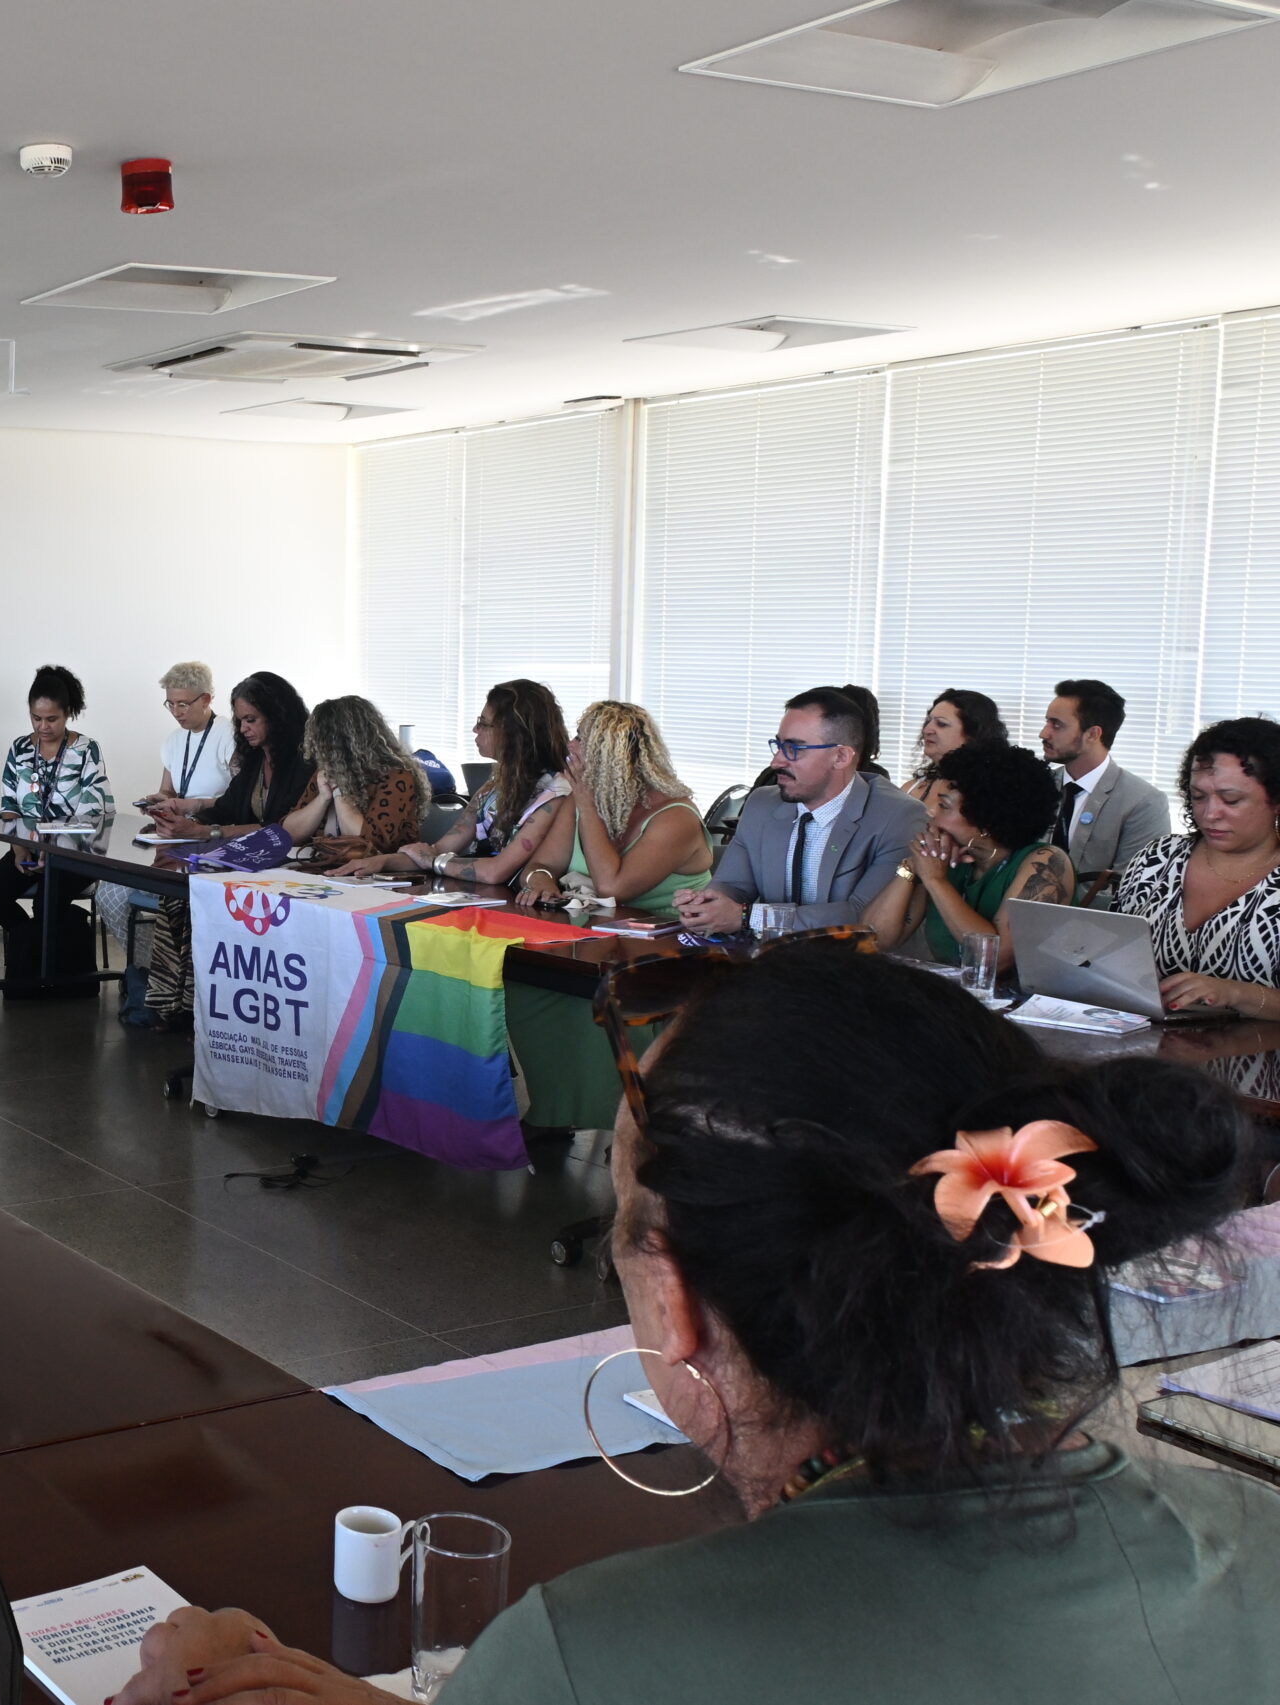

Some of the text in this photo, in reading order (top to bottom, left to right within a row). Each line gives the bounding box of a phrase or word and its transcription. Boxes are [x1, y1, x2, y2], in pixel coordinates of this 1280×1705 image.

[208, 941, 308, 991] AMAS
[209, 983, 309, 1037] LGBT
[208, 1029, 248, 1043] ASSOCIAÇÃO
[270, 1043, 278, 1053] DE
[281, 1046, 308, 1060] PESSOAS
[24, 1608, 126, 1638] TODAS AS MULHERES
[97, 1605, 156, 1626] CIDADANIA
[38, 1615, 156, 1651] E DIREITOS HUMANOS
[45, 1645, 76, 1657] PARA
[77, 1629, 137, 1649] TRAVESTIS
[52, 1634, 145, 1664] MULHERES TRAN
